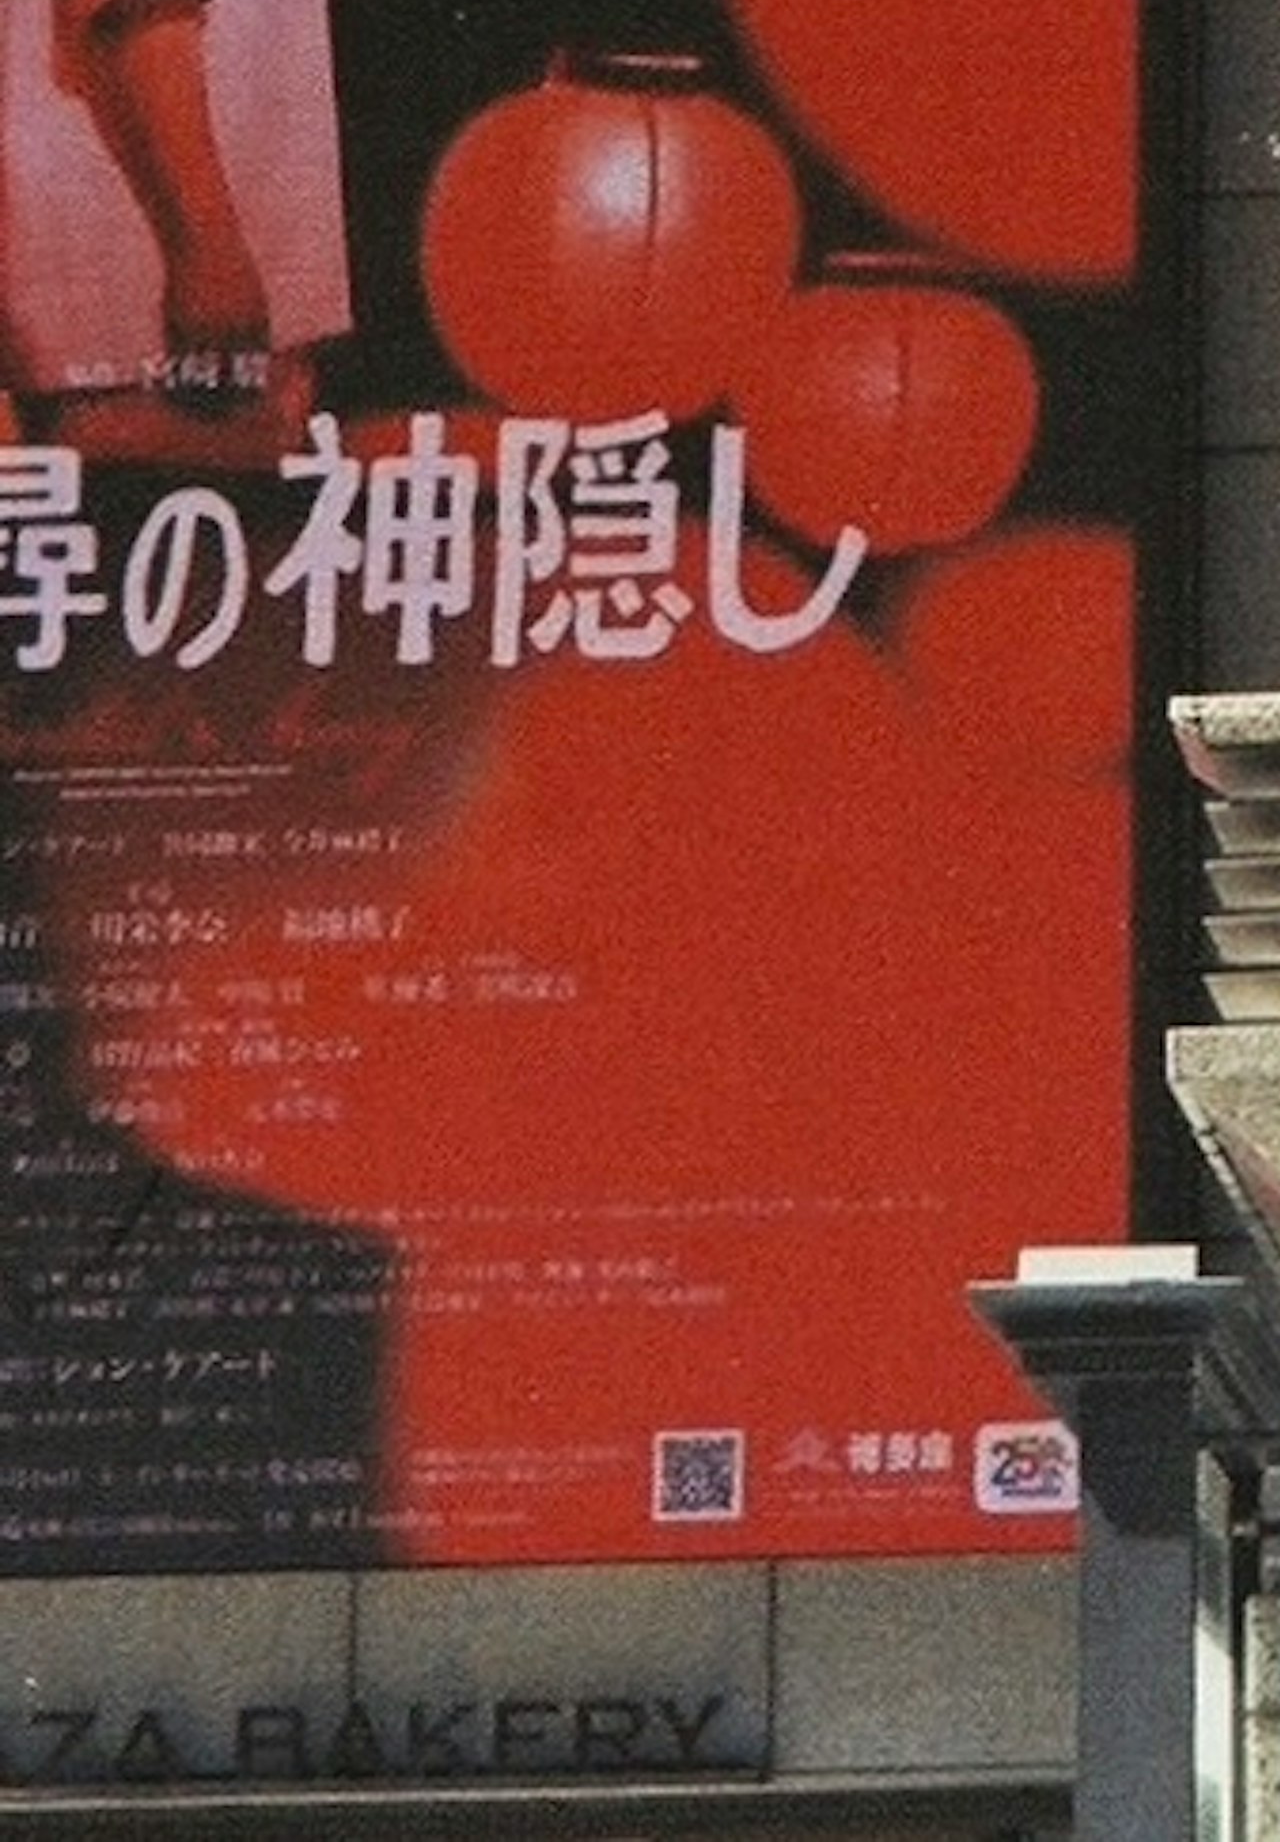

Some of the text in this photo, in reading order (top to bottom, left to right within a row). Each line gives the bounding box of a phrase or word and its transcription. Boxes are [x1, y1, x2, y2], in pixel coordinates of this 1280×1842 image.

[0, 409, 868, 671] 尋の神隠し
[236, 1697, 726, 1777] BAKERY
